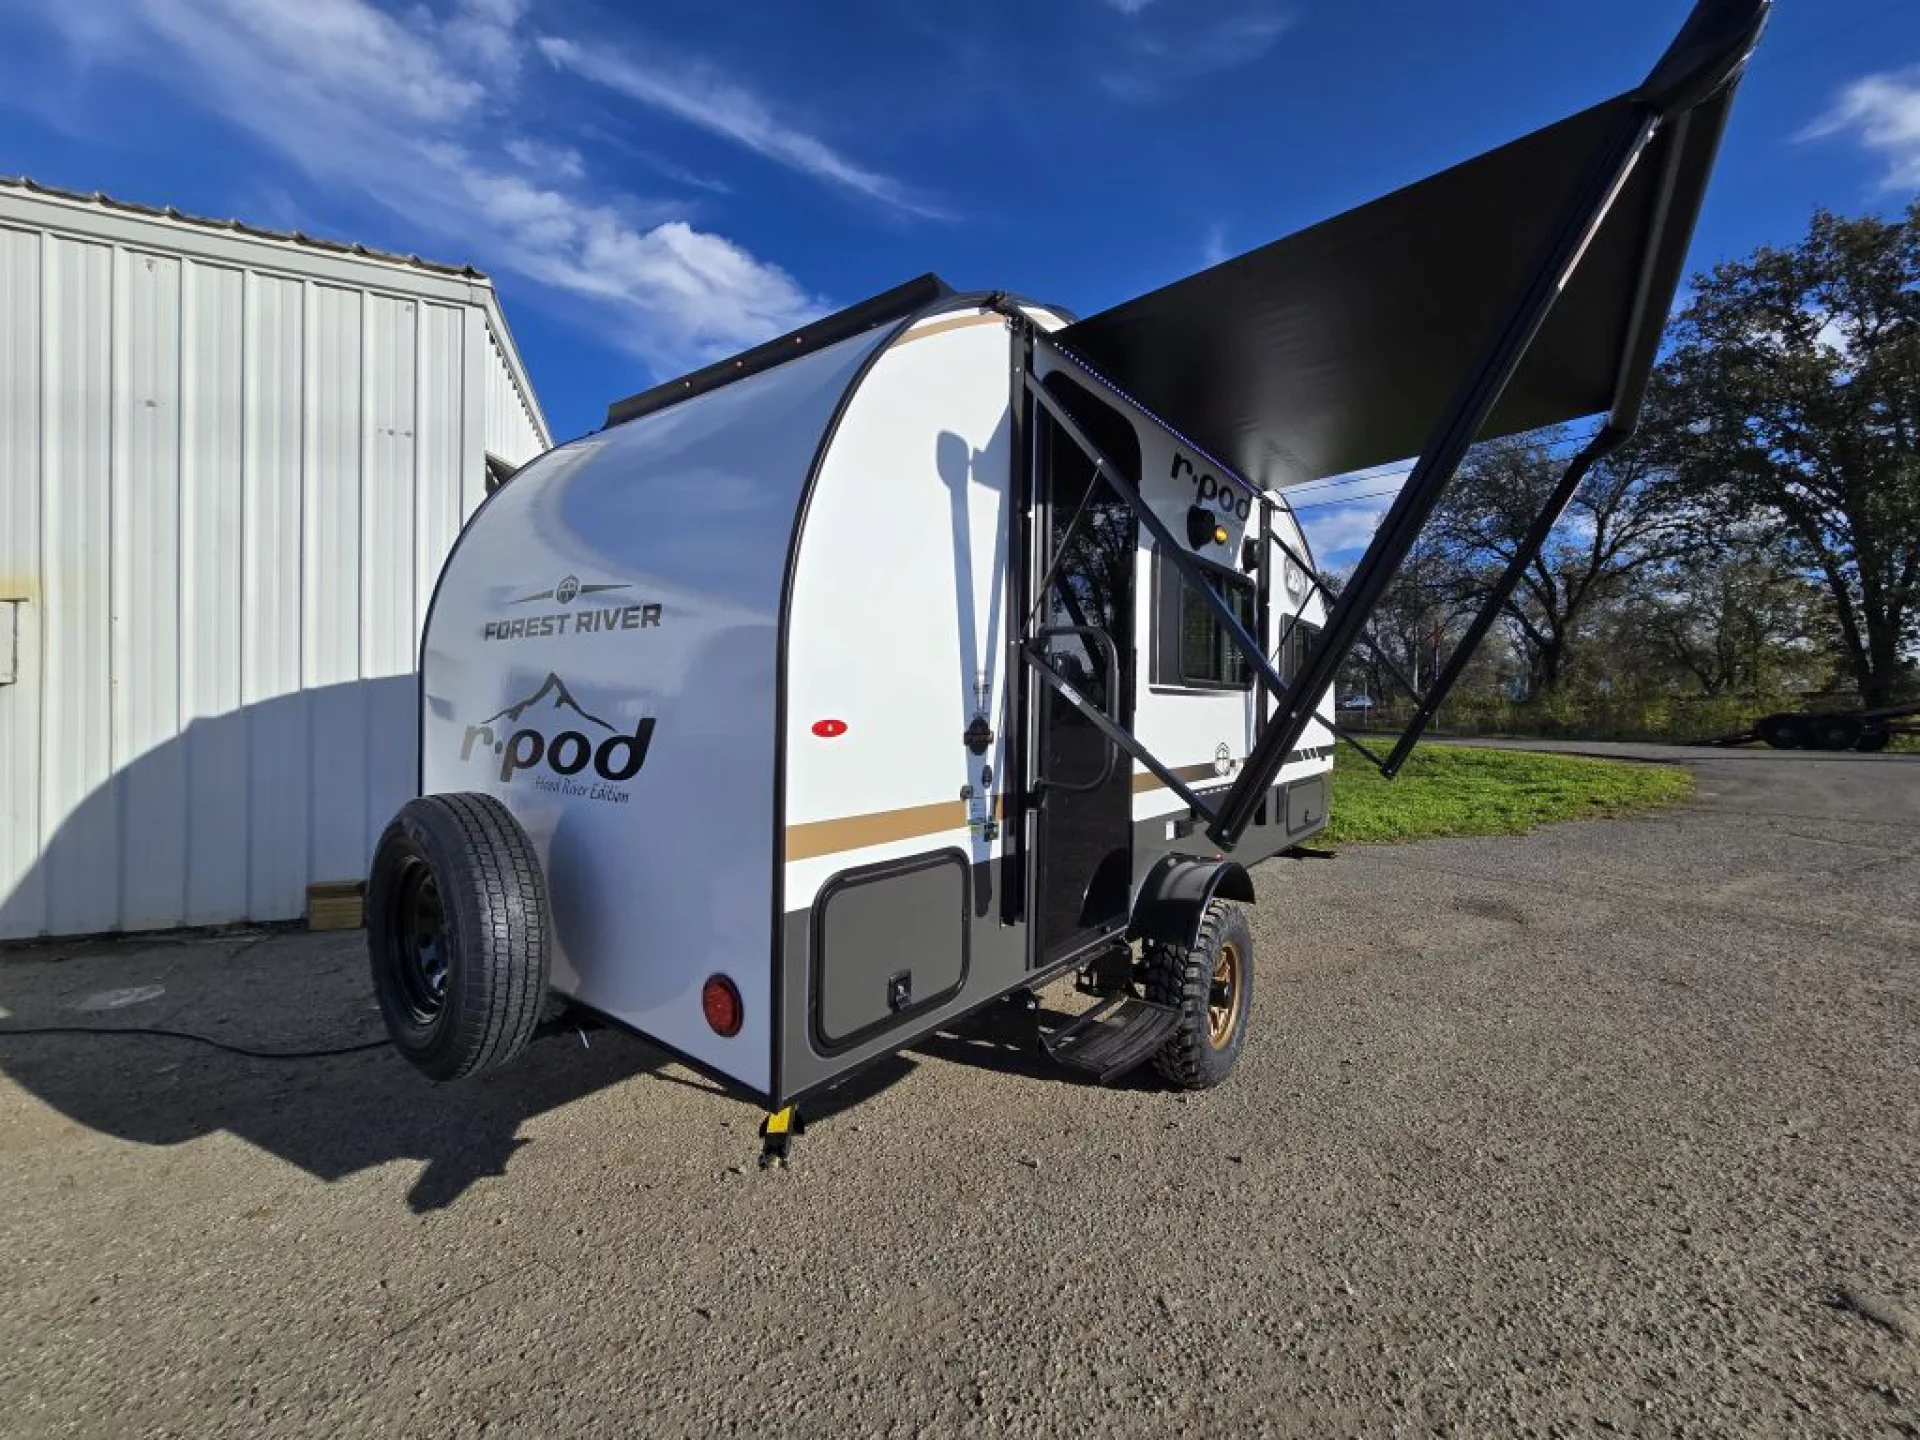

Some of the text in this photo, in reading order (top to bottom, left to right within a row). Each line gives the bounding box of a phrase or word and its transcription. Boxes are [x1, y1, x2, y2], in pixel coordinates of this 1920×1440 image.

[484, 603, 662, 641] FOREST RIVER
[590, 782, 631, 804] Edition
